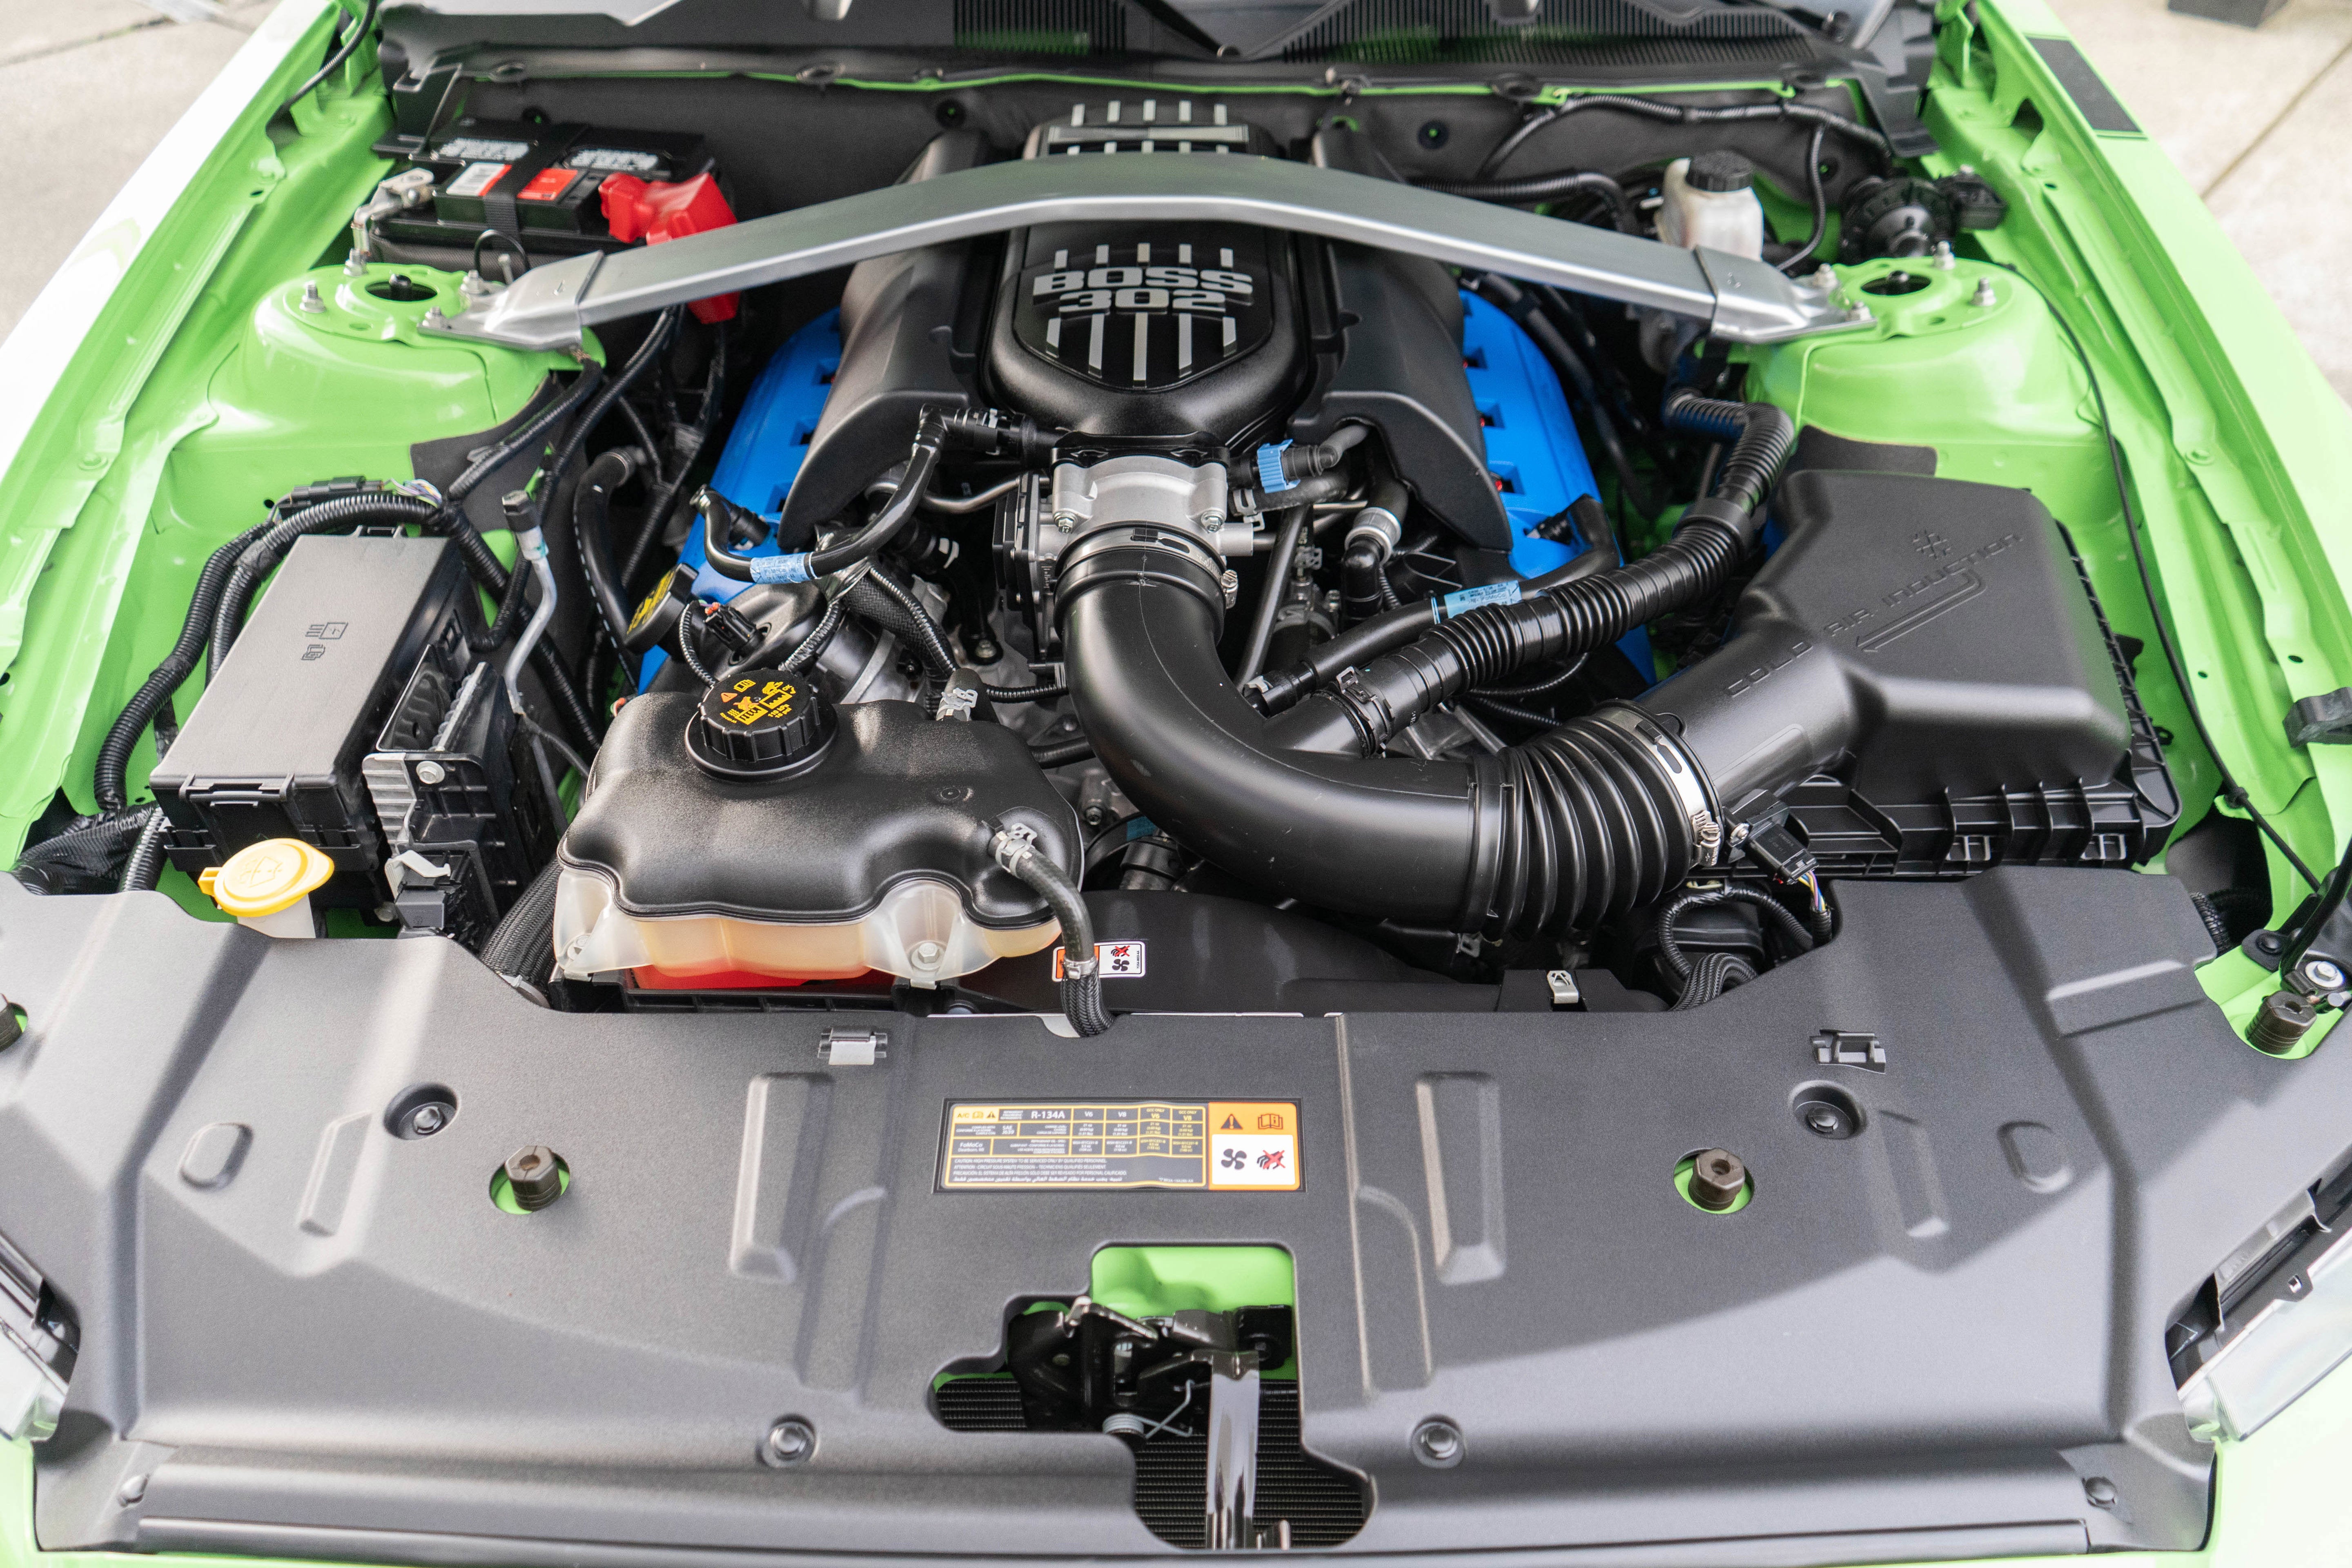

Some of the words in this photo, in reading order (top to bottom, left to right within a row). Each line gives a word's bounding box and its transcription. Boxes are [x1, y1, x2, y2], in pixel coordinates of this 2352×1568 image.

[1033, 266, 1253, 300] BOSS
[1058, 288, 1226, 313] 302
[1725, 641, 1813, 697] COLD
[1824, 608, 1875, 637] AIR
[1882, 533, 2024, 608] INDUCTION
[1031, 1110, 1065, 1119] R-134A
